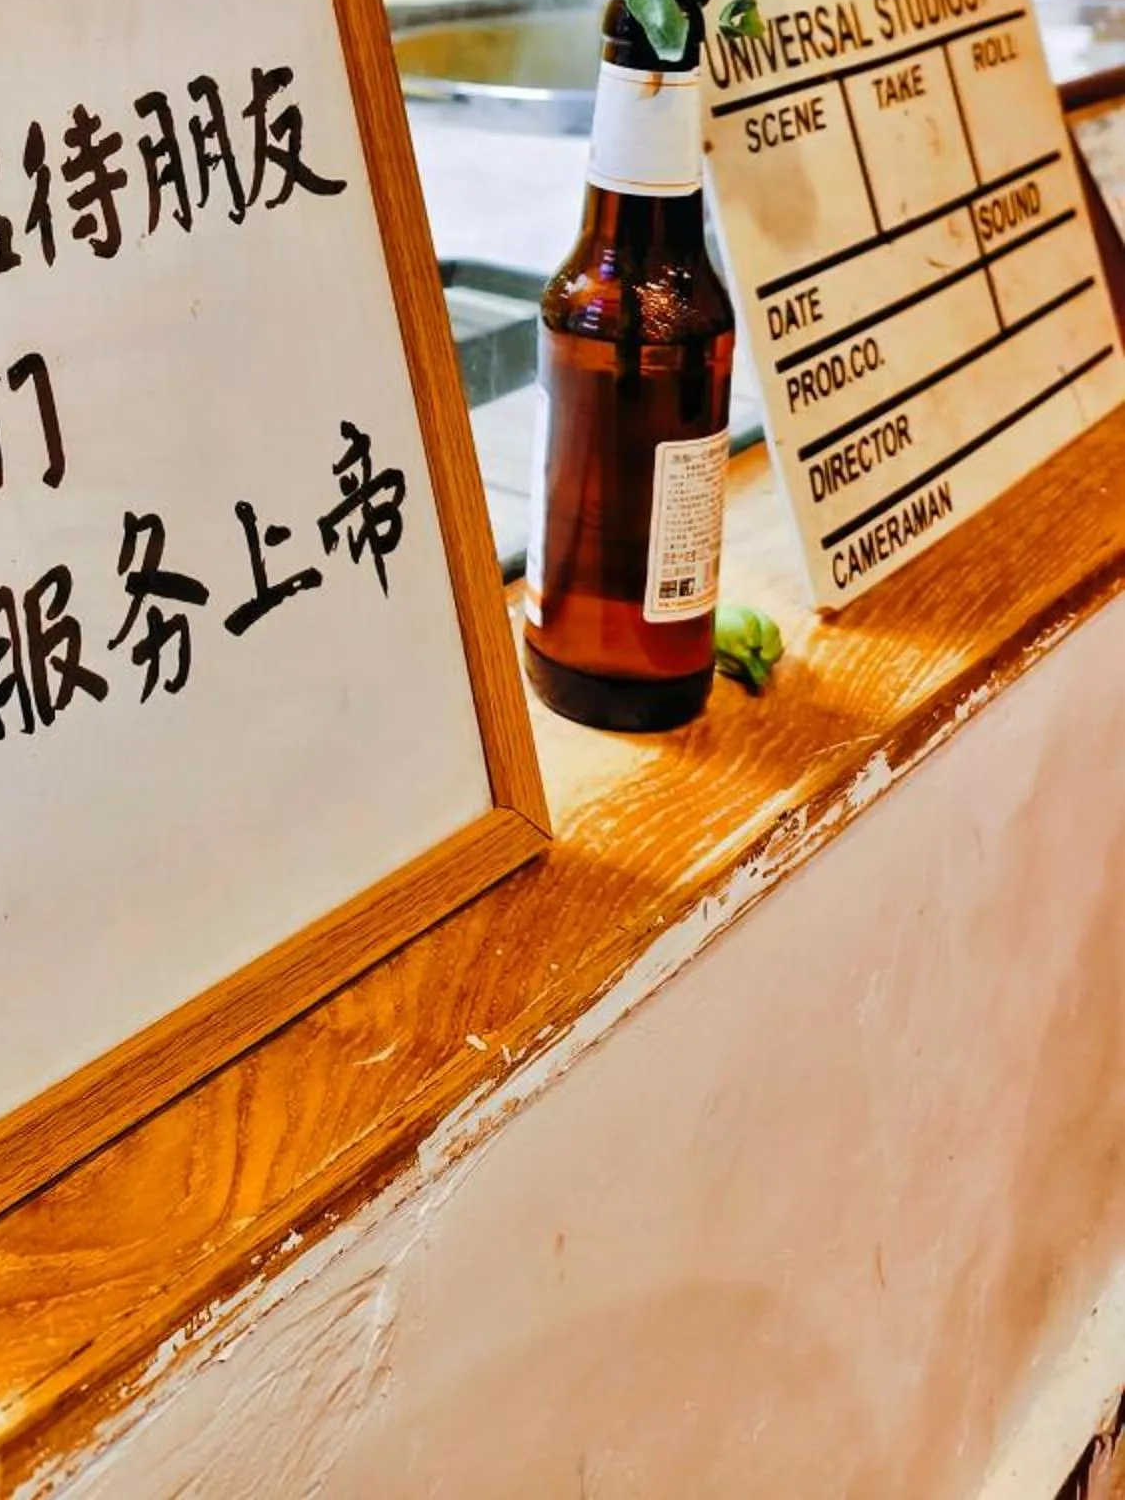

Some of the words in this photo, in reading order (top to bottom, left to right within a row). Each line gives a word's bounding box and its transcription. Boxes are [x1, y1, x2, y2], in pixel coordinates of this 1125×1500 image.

[704, 1, 874, 90] UNIVERSAL
[971, 32, 1018, 71] ROLL
[872, 64, 926, 108] TAKE
[745, 97, 827, 153] SCENE
[978, 181, 1042, 241] SOUND
[767, 287, 823, 340] DATE
[808, 414, 912, 503] DIRECTOR
[832, 481, 953, 589] CAMERAMAN
